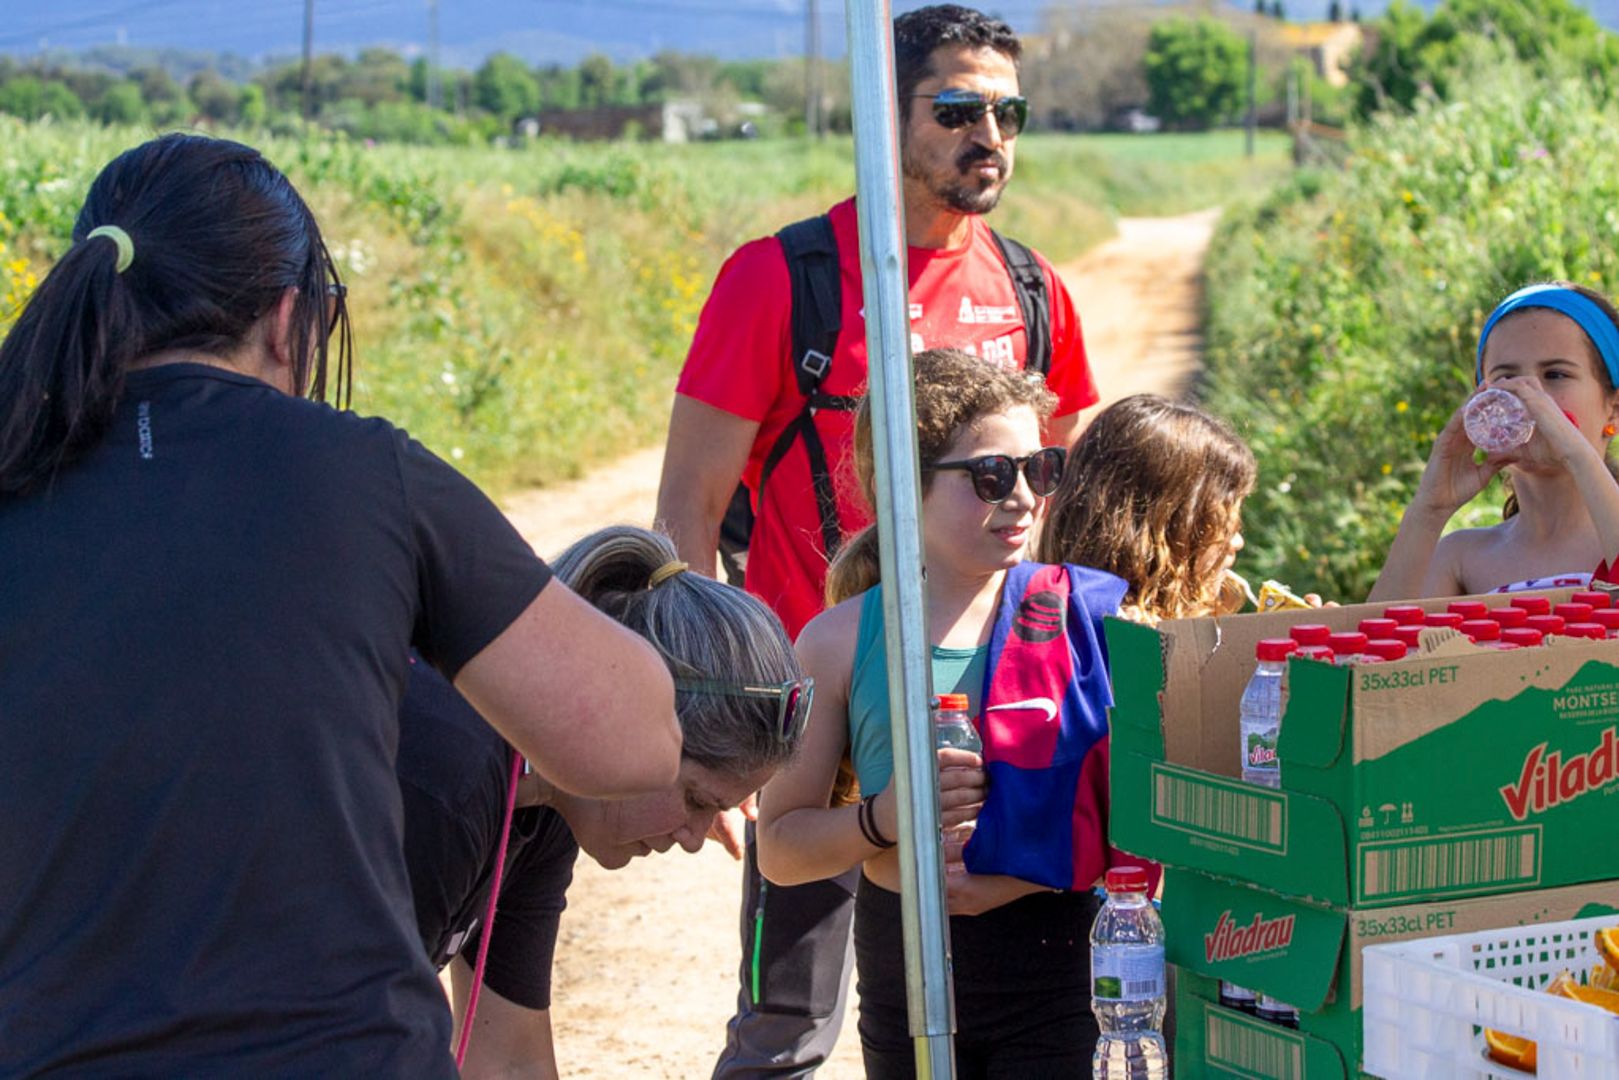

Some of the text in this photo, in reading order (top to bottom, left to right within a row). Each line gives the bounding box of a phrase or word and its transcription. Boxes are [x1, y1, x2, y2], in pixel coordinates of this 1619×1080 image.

[1361, 665, 1459, 691] 35x33cl PET
[1205, 909, 1295, 964] Viladrau
[1358, 911, 1456, 937] 35x33cl PET
